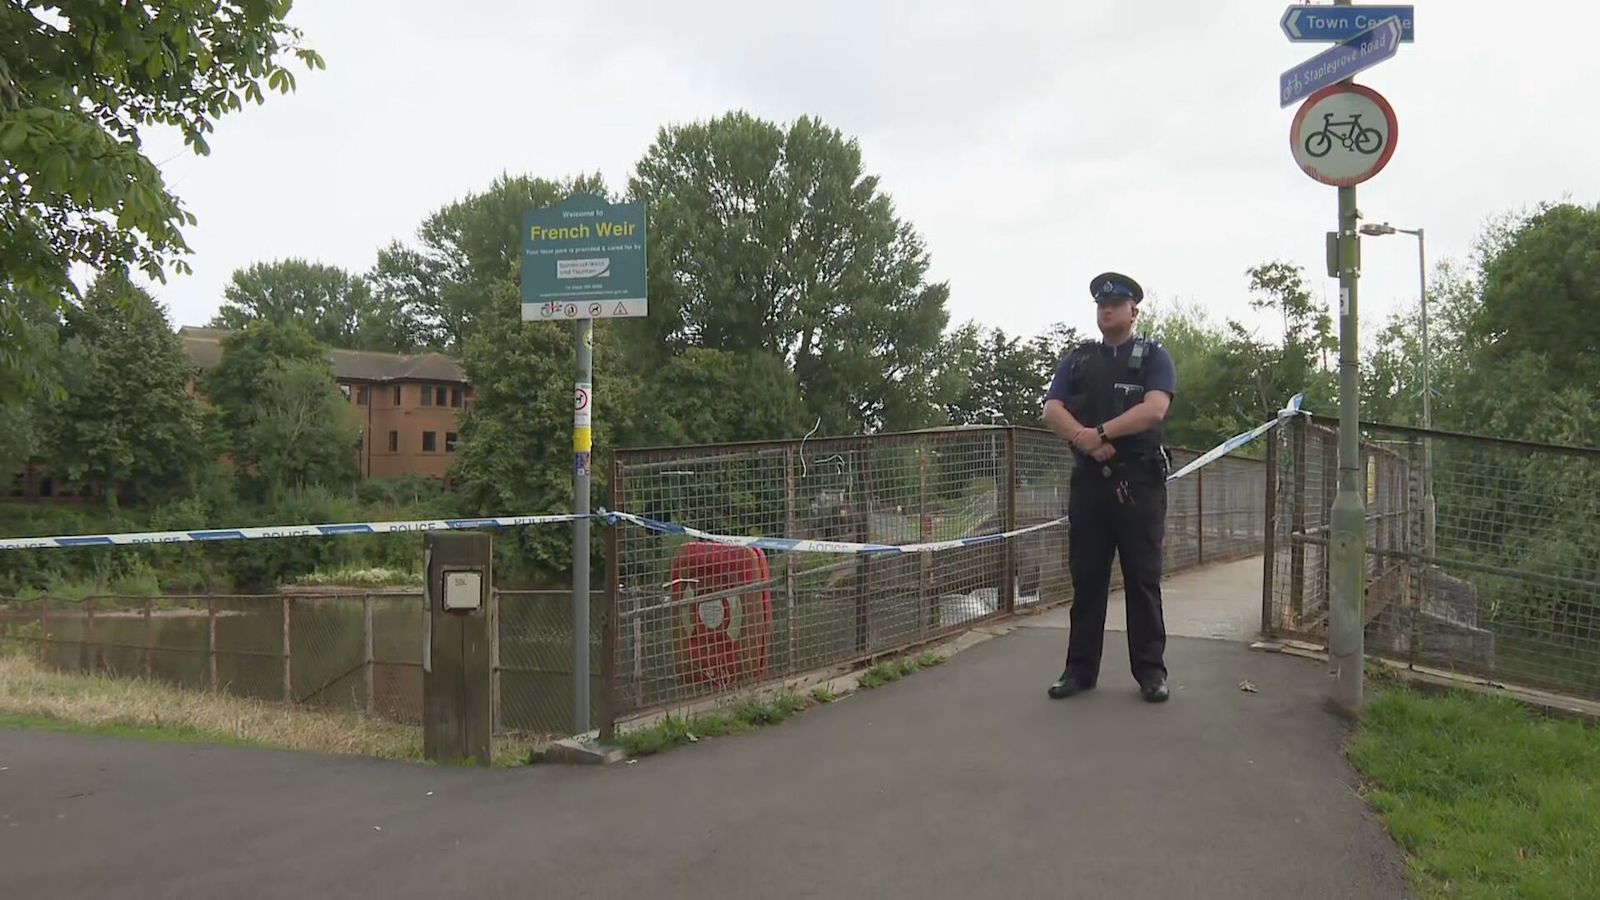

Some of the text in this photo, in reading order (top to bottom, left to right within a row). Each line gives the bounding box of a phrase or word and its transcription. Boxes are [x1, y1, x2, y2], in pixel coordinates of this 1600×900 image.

[1307, 15, 1411, 29] Town Cee
[1304, 32, 1386, 84] Staplegrove Road
[562, 209, 604, 219] Welcome to
[531, 221, 635, 241] French Weir
[575, 246, 600, 254] provided
[633, 243, 641, 251] by
[389, 522, 436, 533] POLICE
